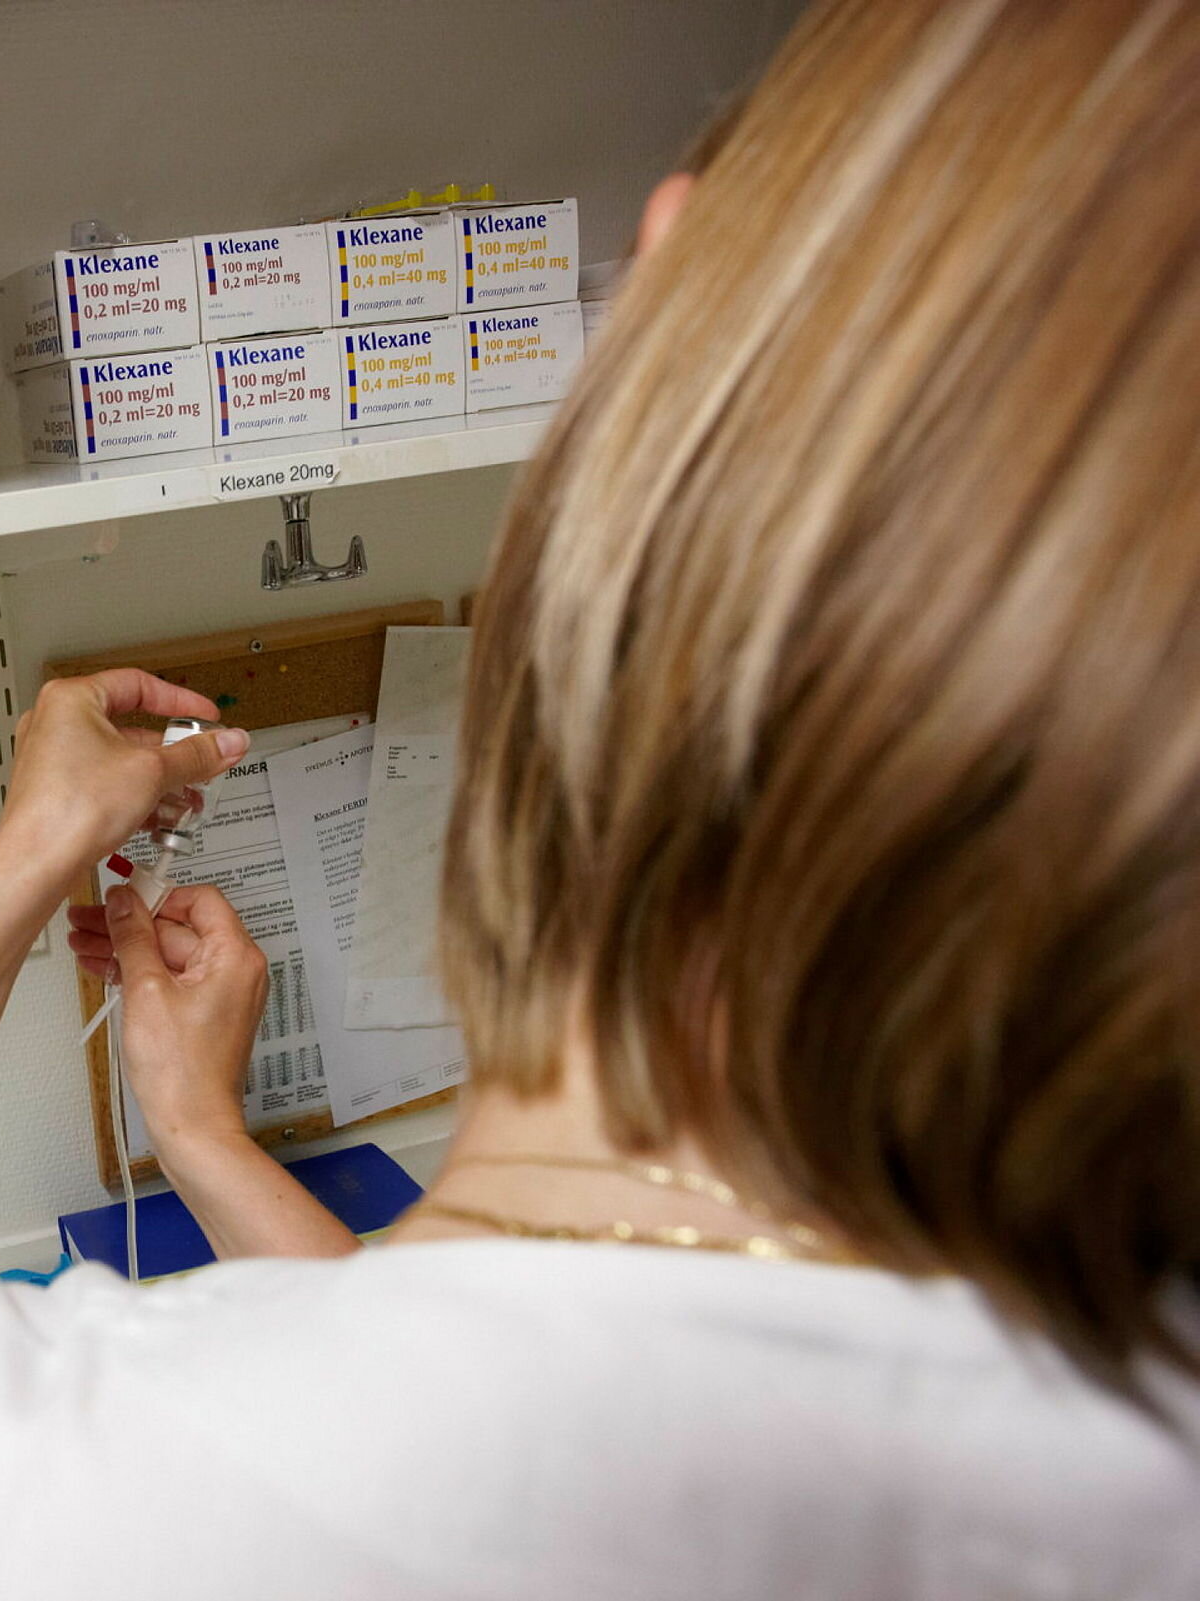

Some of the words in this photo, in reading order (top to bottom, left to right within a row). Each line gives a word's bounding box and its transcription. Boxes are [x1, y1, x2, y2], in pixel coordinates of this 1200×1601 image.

[475, 214, 547, 234] Klexane
[218, 238, 279, 256] Klexane
[350, 226, 423, 247] Klexane
[477, 242, 500, 256] 100
[504, 236, 547, 254] mg/ml
[79, 253, 159, 276] Klexane
[222, 262, 243, 274] 100
[246, 257, 283, 272] mg/ml
[352, 254, 377, 268] 100
[381, 248, 424, 267] mg/ml
[478, 262, 498, 276] 0,4
[502, 257, 545, 272] ml=40
[549, 255, 569, 270] mg
[82, 283, 108, 299] 100
[114, 277, 160, 297] mg/ml
[222, 277, 241, 290] 0,2
[244, 273, 280, 286] ml=20
[284, 271, 301, 284] mg
[353, 275, 373, 290] 0,4
[378, 270, 422, 285] ml=40
[426, 269, 447, 284] mg
[84, 304, 108, 321] 0,2
[112, 299, 159, 315] ml=20
[165, 298, 187, 313] mg
[482, 316, 539, 333] Klexane
[358, 330, 431, 351] Klexane
[484, 340, 503, 350] 100
[506, 334, 541, 348] mg/ml
[228, 343, 305, 367] Klexane
[361, 358, 385, 373] 100
[389, 353, 432, 371] mg/ml
[484, 355, 501, 366] 0,4
[504, 351, 537, 363] ml=40
[540, 349, 557, 359] mg
[94, 360, 173, 383] Klexane
[231, 375, 257, 389] 100
[261, 367, 306, 387] mg/ml
[361, 379, 382, 393] 0,4
[387, 373, 430, 388] ml=40
[435, 372, 456, 386] mg
[96, 389, 123, 406] 100
[127, 383, 174, 403] mg/ml
[233, 393, 256, 410] 0,2
[259, 389, 305, 405] ml=20
[310, 386, 331, 402] mg
[98, 410, 122, 427] 0,2
[126, 404, 173, 421] ml=20
[178, 402, 200, 418] mg
[220, 470, 285, 494] Klexane
[290, 462, 334, 488] 20mg
